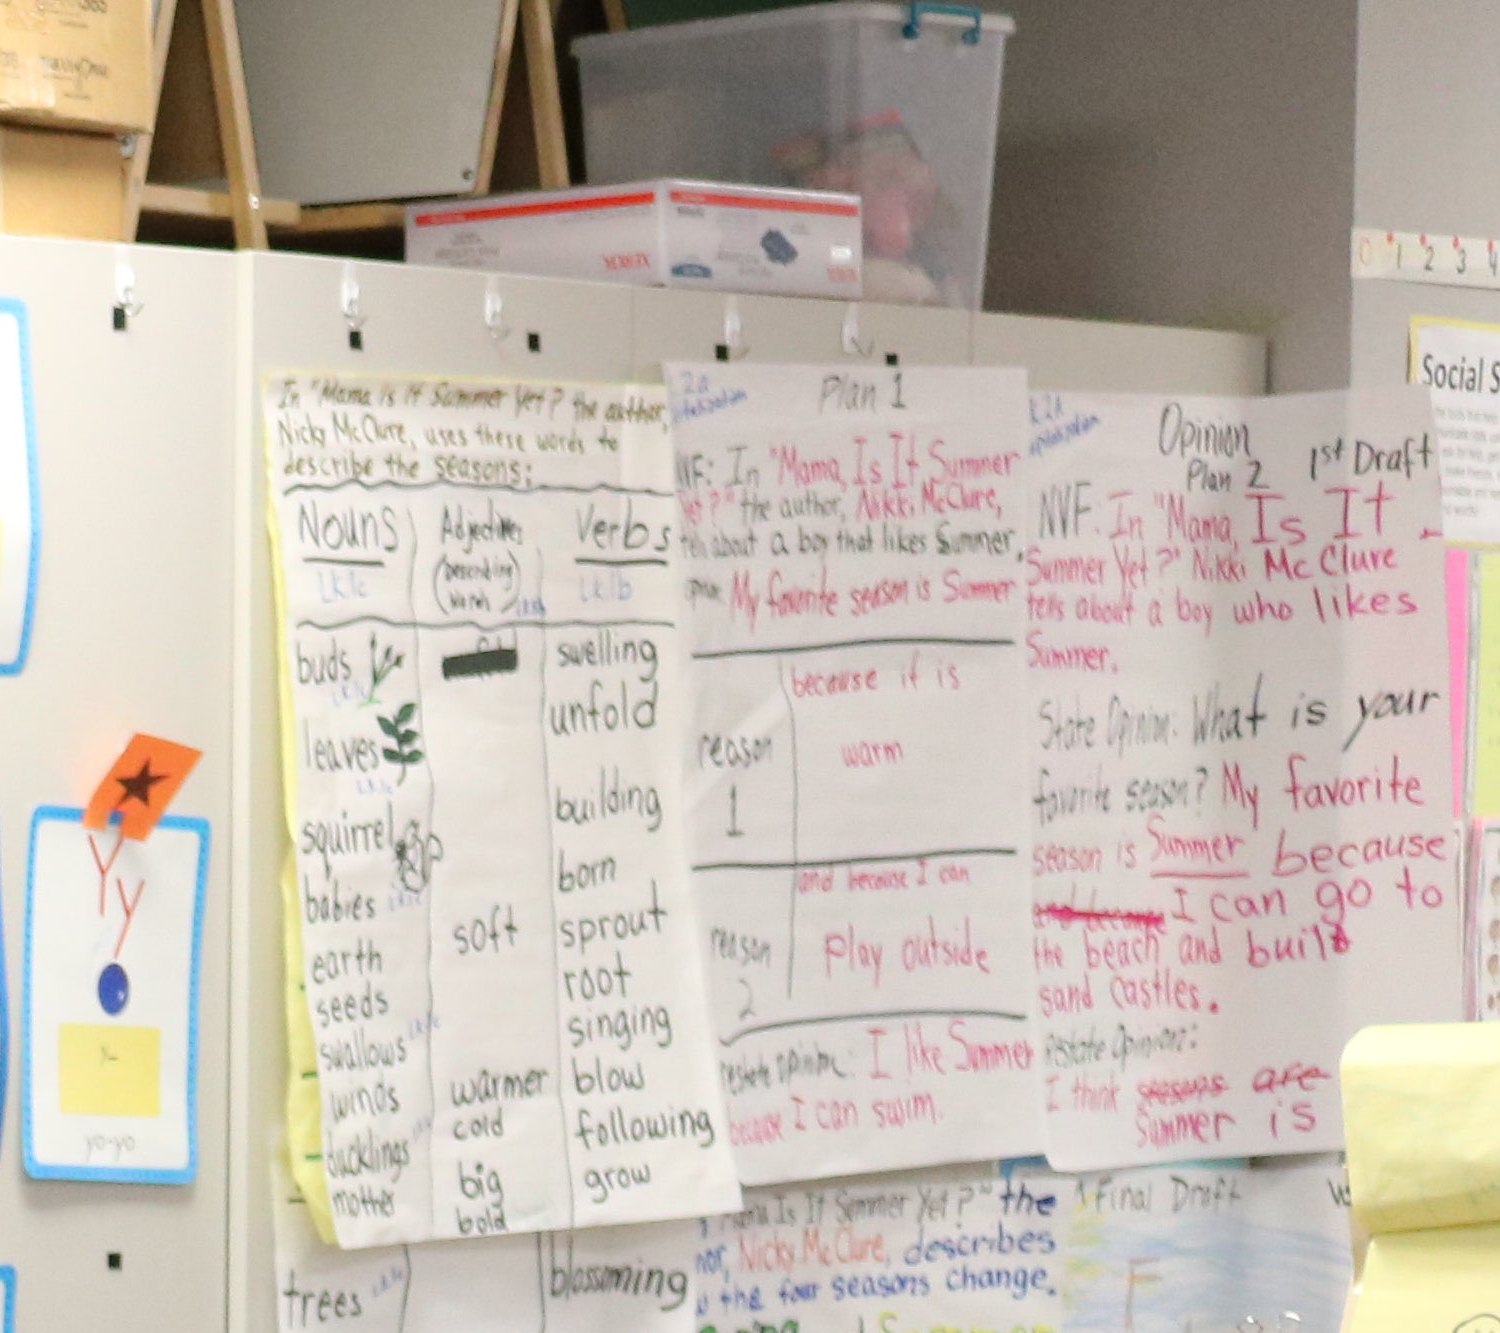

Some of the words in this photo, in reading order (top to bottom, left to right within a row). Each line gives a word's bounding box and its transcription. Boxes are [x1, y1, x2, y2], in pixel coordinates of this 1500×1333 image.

[1422, 352, 1485, 394] Social
[1354, 432, 1435, 480] Draft
[299, 503, 399, 554] Nouns
[574, 503, 673, 552] Verbs
[1324, 478, 1397, 541] It
[1233, 590, 1295, 625] who
[1313, 585, 1420, 625] likes
[297, 637, 353, 686] buds
[557, 634, 659, 684] swelling
[304, 722, 380, 773] leaves
[550, 680, 659, 736] unfold
[1341, 689, 1441, 752] your
[555, 765, 663, 832] building
[1284, 752, 1427, 813] favorite
[557, 849, 617, 893] born
[1271, 828, 1448, 879] because
[1396, 865, 1445, 912] to
[453, 904, 519, 956] soft
[559, 878, 669, 953] sprout
[902, 914, 991, 975] outside
[312, 940, 384, 986] earth
[564, 950, 632, 1001] root
[316, 982, 390, 1029] seeds
[568, 1004, 673, 1050] singing
[450, 1068, 550, 1107] warmer
[573, 1057, 646, 1095] blow
[453, 1107, 505, 1141] cold
[574, 1106, 716, 1150] following
[458, 1160, 504, 1202] big
[584, 1162, 652, 1203] grow
[456, 1207, 508, 1234] bold
[283, 1269, 363, 1330] trees
